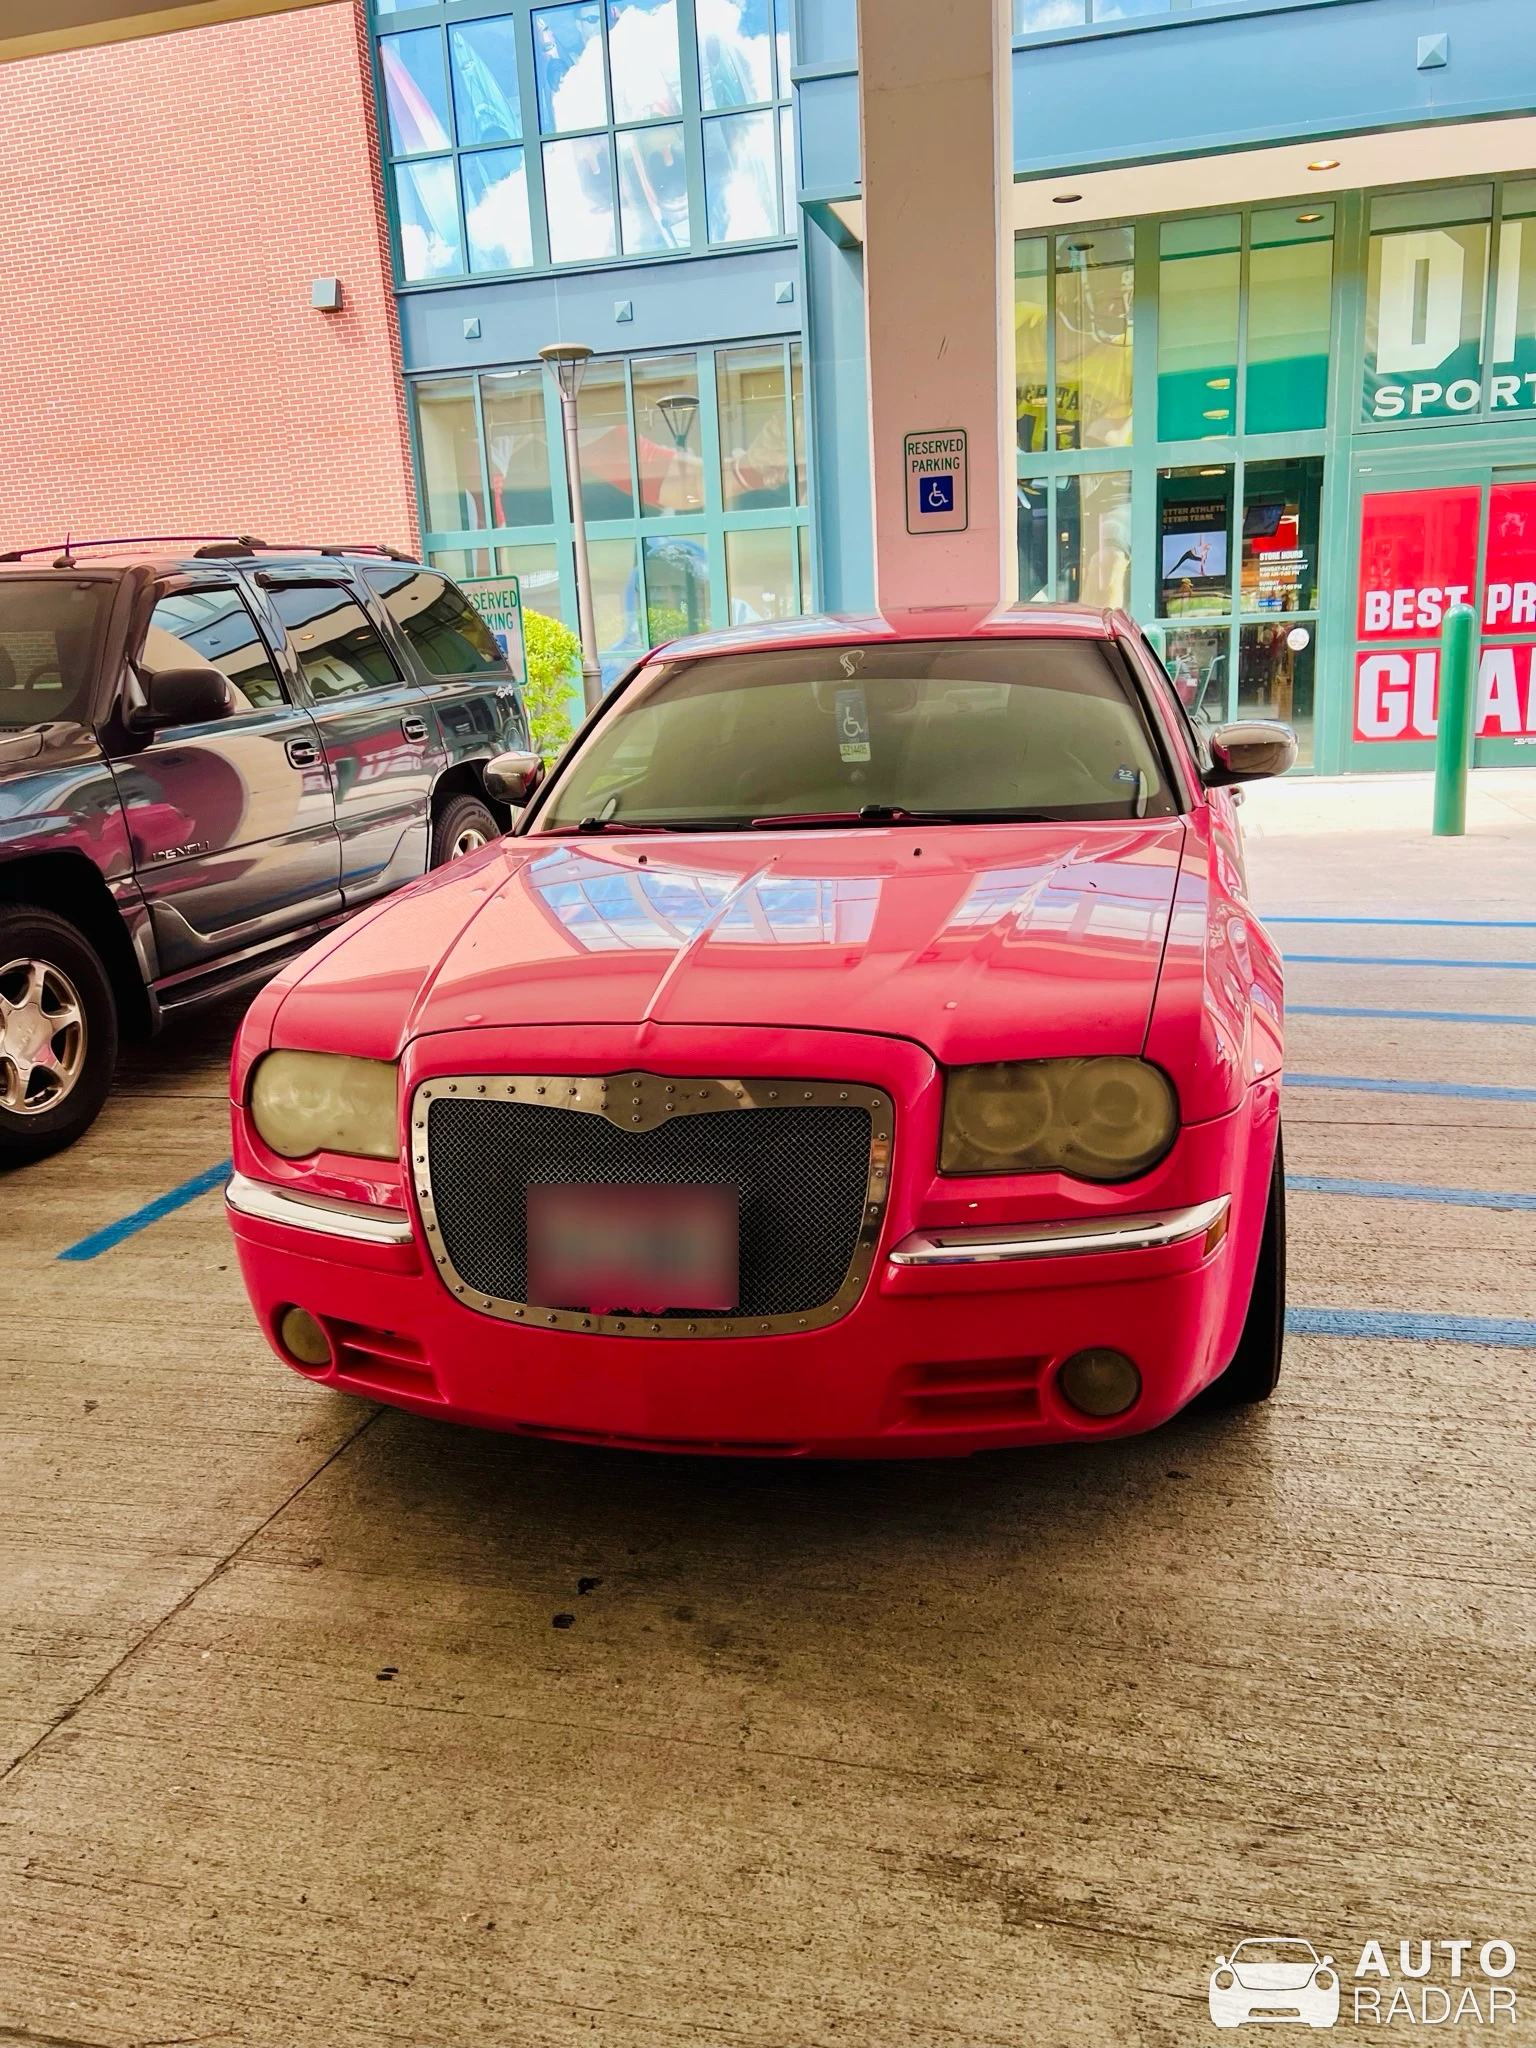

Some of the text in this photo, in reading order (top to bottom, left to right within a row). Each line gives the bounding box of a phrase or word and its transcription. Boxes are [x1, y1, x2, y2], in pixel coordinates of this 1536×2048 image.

[907, 439, 964, 456] RESERVED
[912, 457, 960, 473] PARKING
[1365, 586, 1468, 631] BEST
